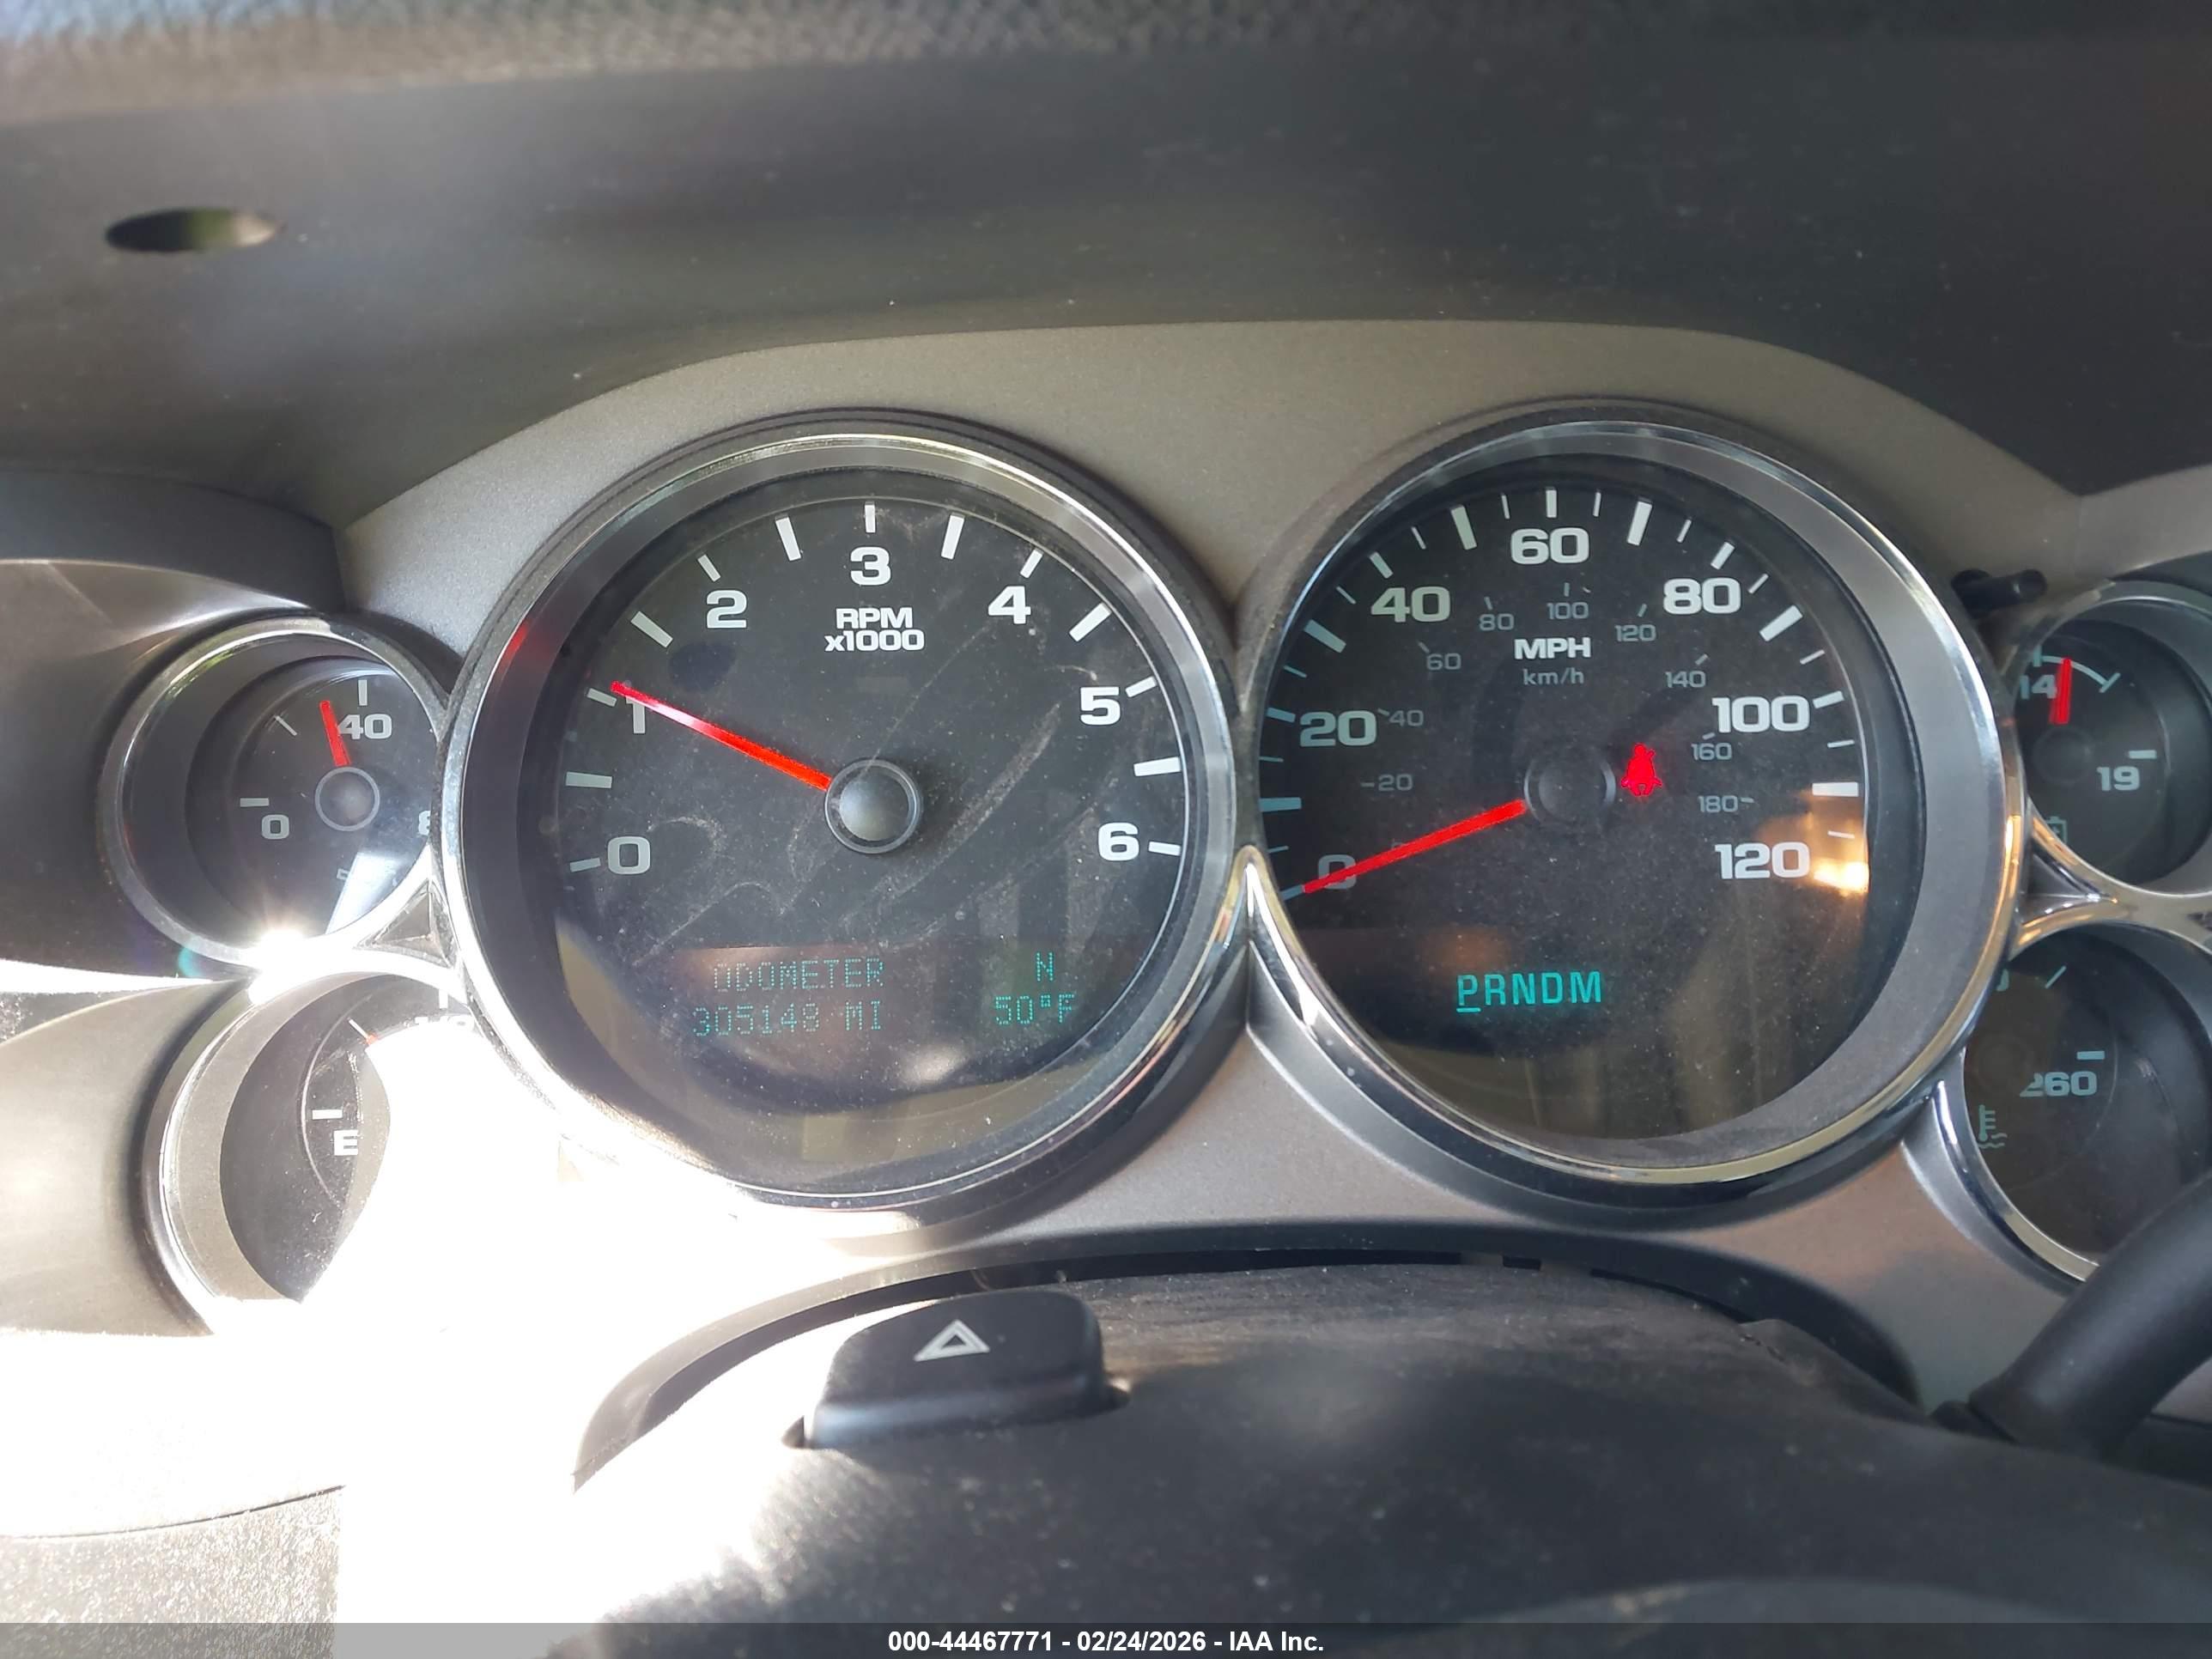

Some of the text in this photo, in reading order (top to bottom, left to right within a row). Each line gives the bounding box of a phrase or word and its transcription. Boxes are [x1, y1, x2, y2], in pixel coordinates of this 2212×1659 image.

[1510, 528, 1589, 564] 60
[851, 547, 890, 586] 3
[706, 590, 747, 629] 2
[988, 586, 1030, 624] 4
[1370, 586, 1451, 623] 40
[1547, 601, 1589, 620] 100
[1662, 577, 1741, 615] 80
[836, 607, 914, 629] RPM
[1479, 613, 1515, 631] 80
[824, 629, 925, 652] x1000
[1615, 624, 1656, 642] 120
[1426, 653, 1462, 671] 60
[1514, 637, 1591, 659] MPH
[1522, 668, 1584, 684] km/h
[1665, 670, 1706, 689] 140
[625, 694, 646, 734] 1
[1079, 687, 1121, 726] 5
[1388, 709, 1424, 727] 40
[1711, 696, 1810, 732] 100
[337, 714, 392, 739] 40
[1299, 710, 1376, 747] 20
[1692, 742, 1732, 760] 160
[1377, 774, 1413, 791] 20
[2096, 765, 2141, 791] 19
[1698, 793, 1738, 811] 180
[261, 814, 289, 840] 0
[1098, 823, 1139, 860] 6
[607, 836, 650, 875] 0
[1714, 842, 1810, 878] 120
[1317, 854, 1357, 890] 0
[714, 957, 884, 991] ODOMETER
[1036, 952, 1055, 981] N
[1456, 971, 1601, 1006] PRNDM
[693, 1000, 881, 1036] 305148 MI
[334, 1130, 358, 1156] E
